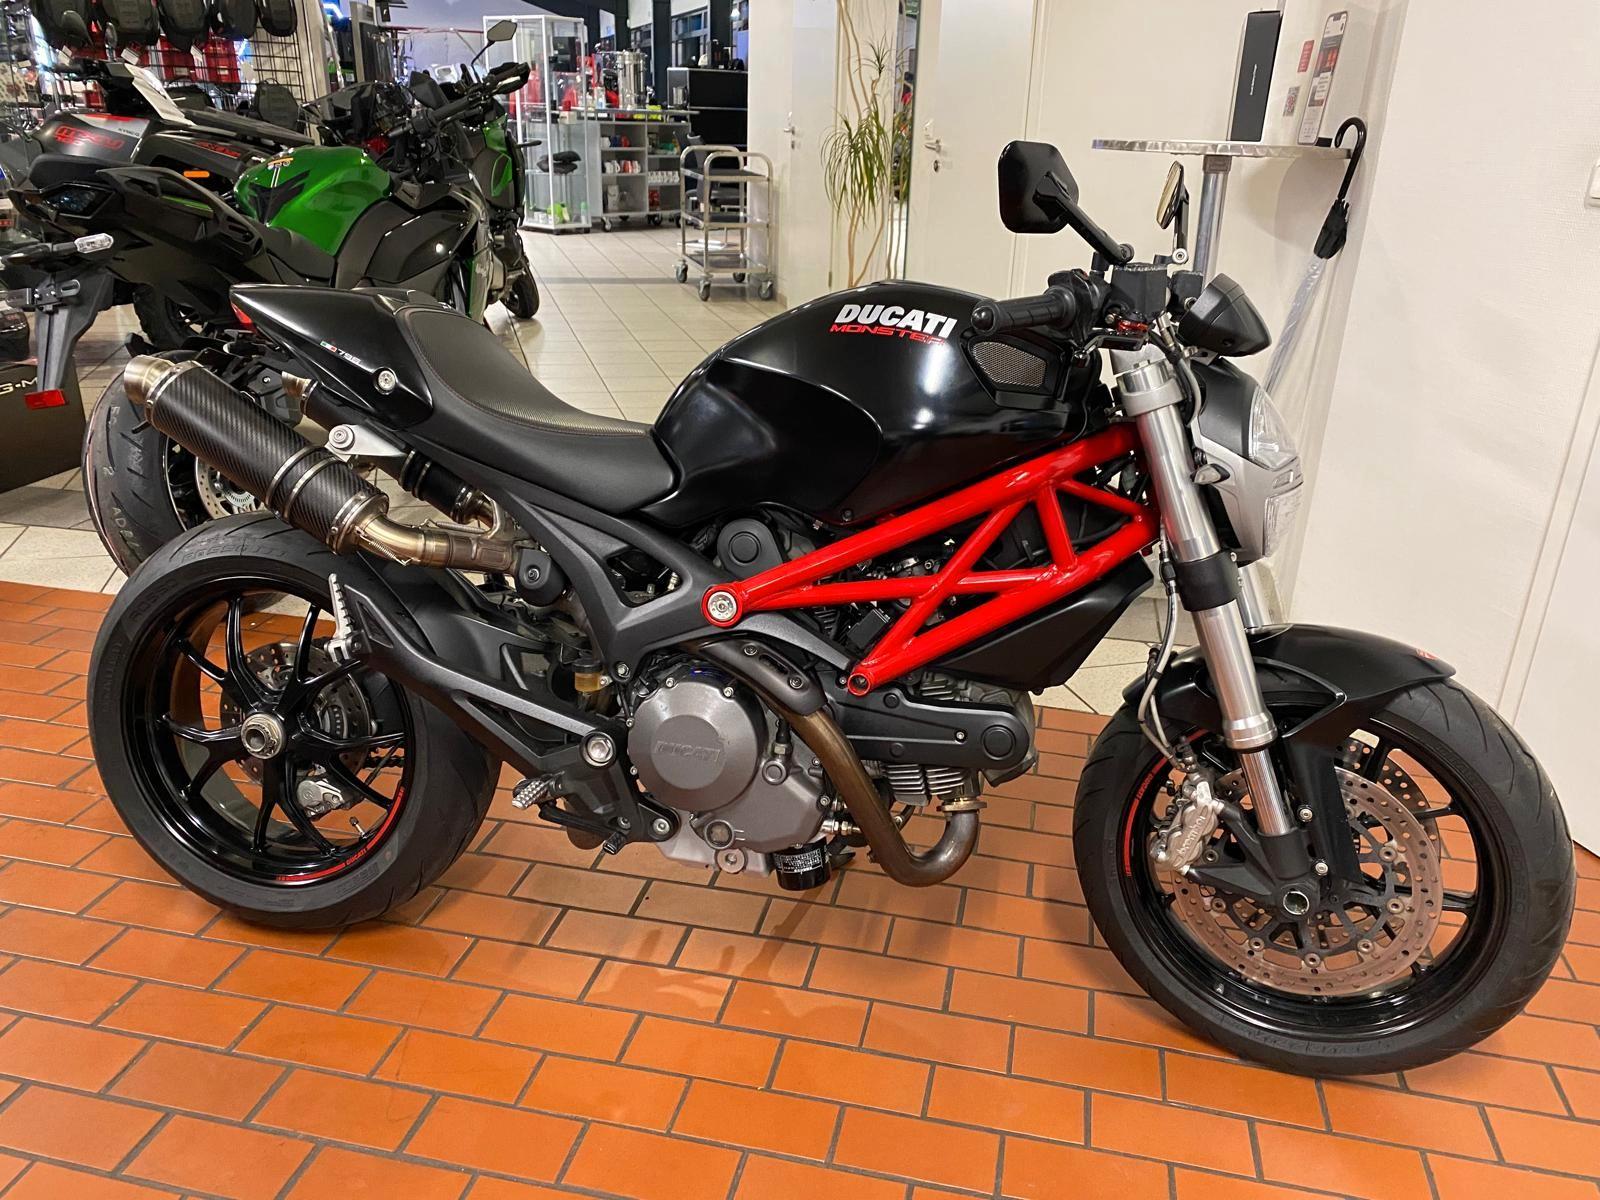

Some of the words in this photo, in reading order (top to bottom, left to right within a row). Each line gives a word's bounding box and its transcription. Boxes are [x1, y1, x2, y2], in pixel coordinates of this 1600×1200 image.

[834, 304, 957, 339] DUCATI
[830, 324, 945, 345] MONSTER
[655, 741, 721, 762] DUCATI
